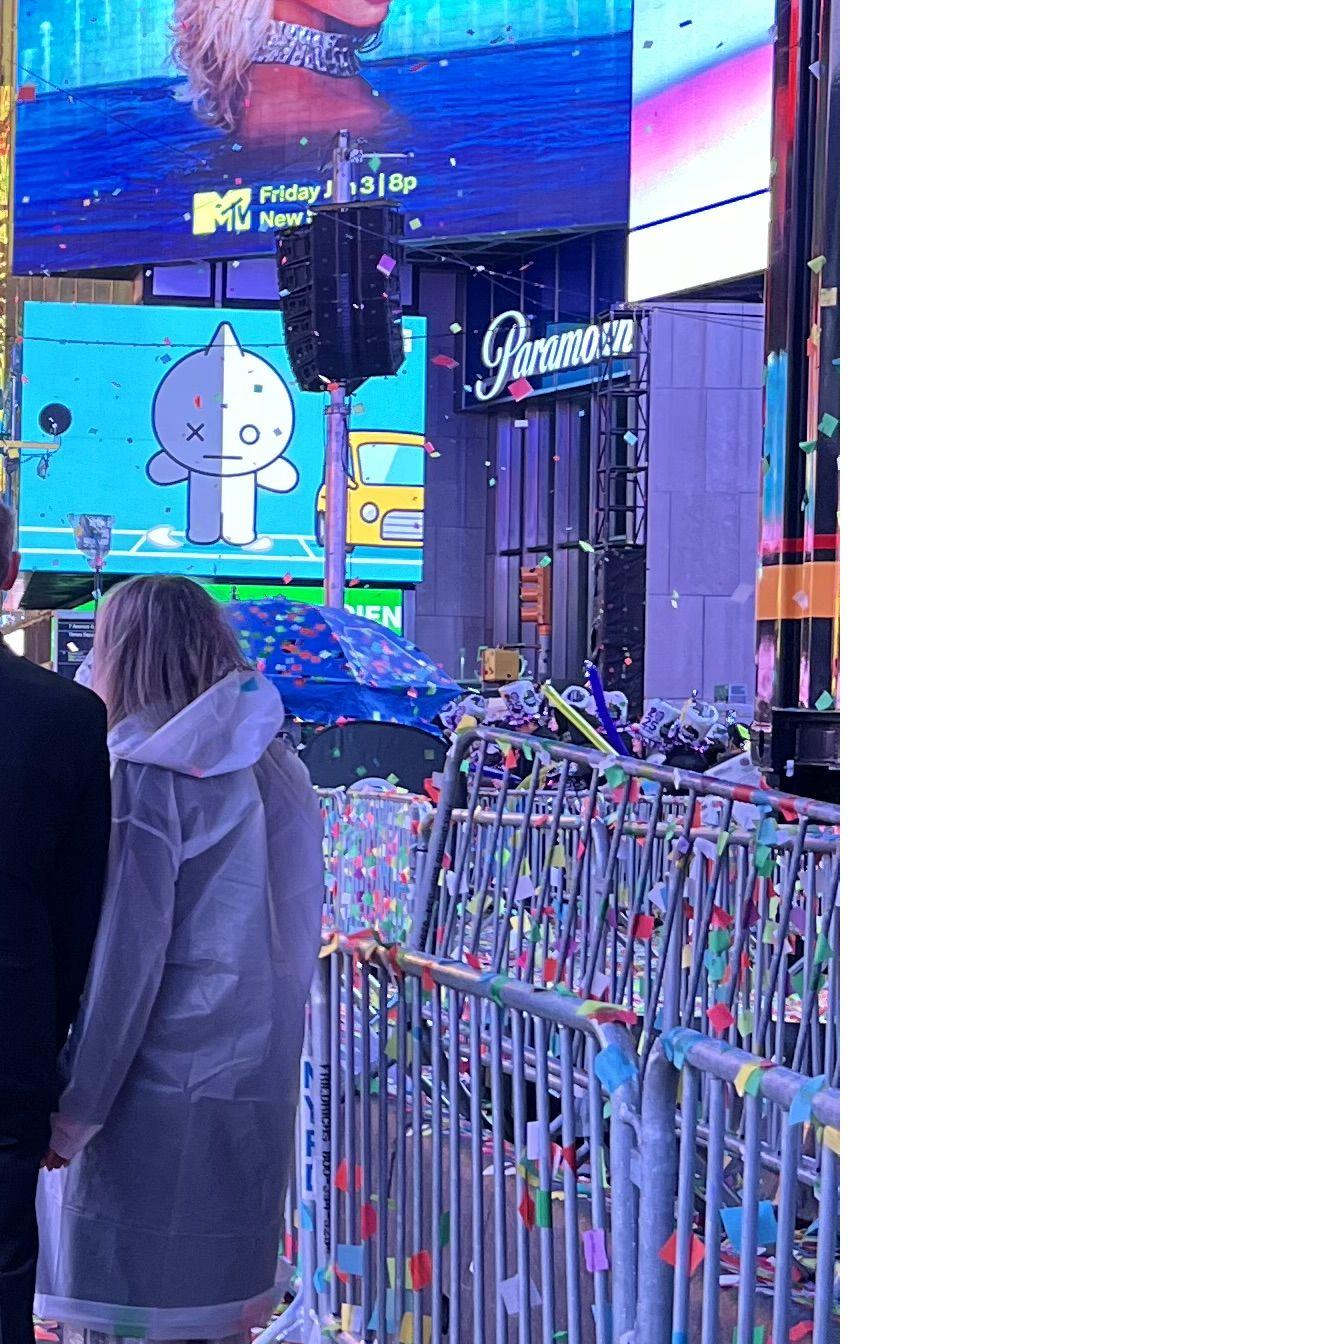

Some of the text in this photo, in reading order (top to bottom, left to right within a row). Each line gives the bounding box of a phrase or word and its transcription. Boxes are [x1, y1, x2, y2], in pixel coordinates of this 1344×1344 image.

[259, 183, 321, 205] Friday
[359, 175, 376, 195] 3
[388, 173, 418, 196] 8p
[193, 188, 252, 235] MTV
[258, 210, 305, 229] New
